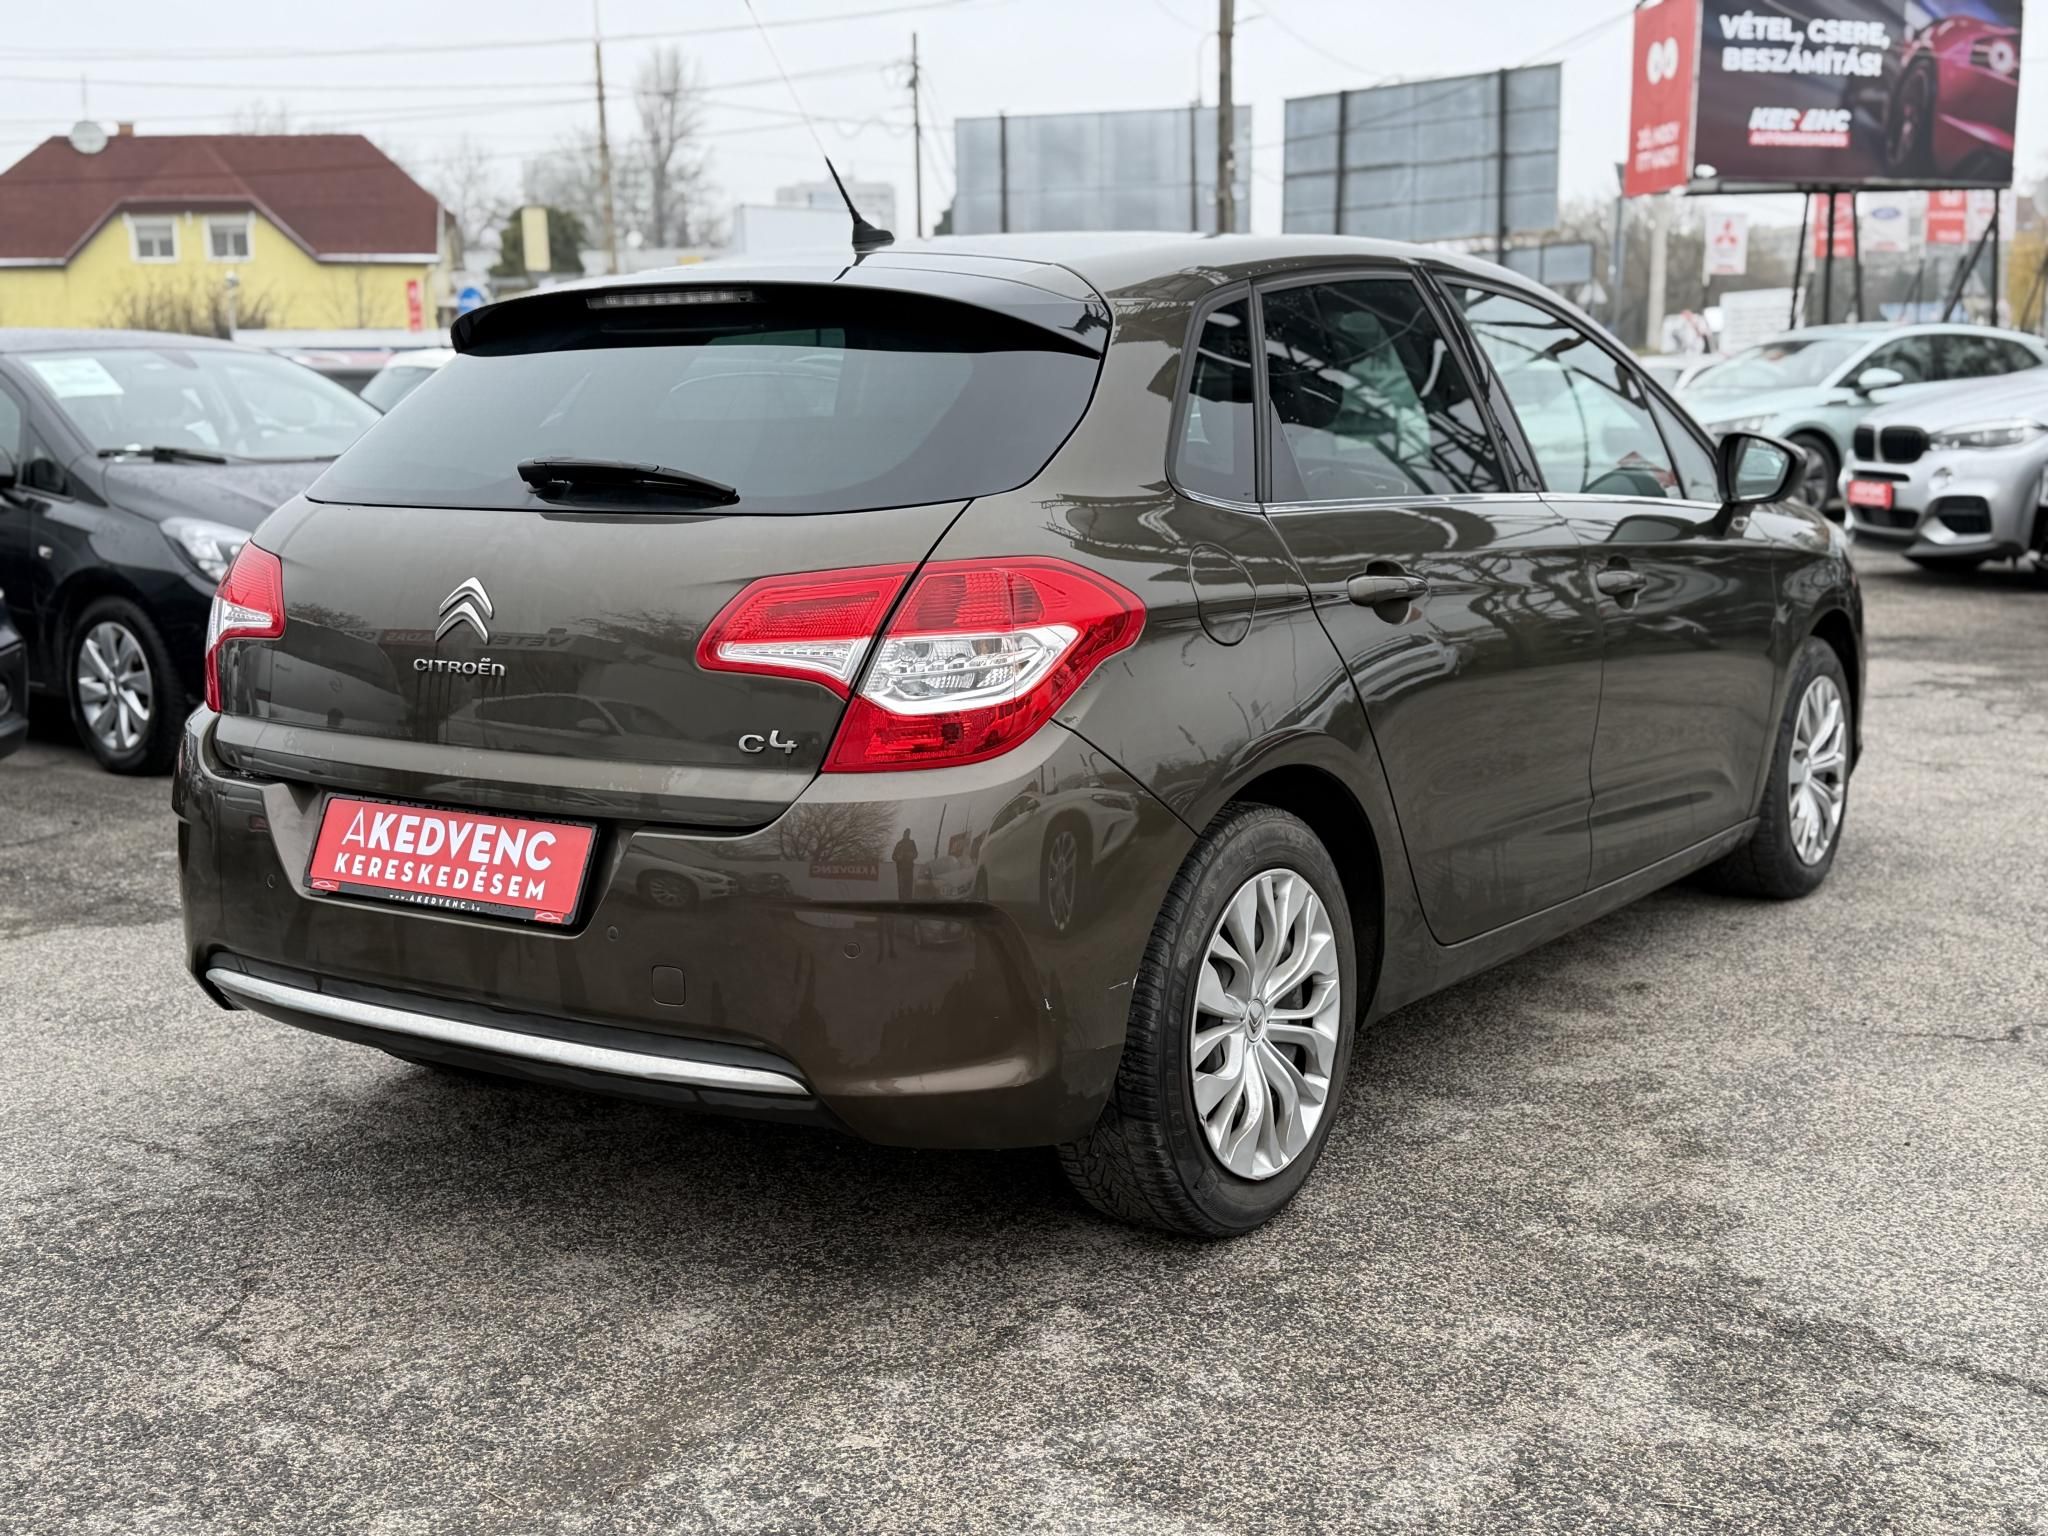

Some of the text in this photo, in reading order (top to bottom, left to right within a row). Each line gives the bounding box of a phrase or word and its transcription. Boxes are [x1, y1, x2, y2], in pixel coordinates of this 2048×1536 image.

[1719, 10, 1891, 49] VÉTEL, CSERE,
[1722, 44, 1882, 76] BESZÁMÍTÁS!
[738, 730, 798, 753] C4
[334, 852, 546, 901] KERESKEDÉSEM
